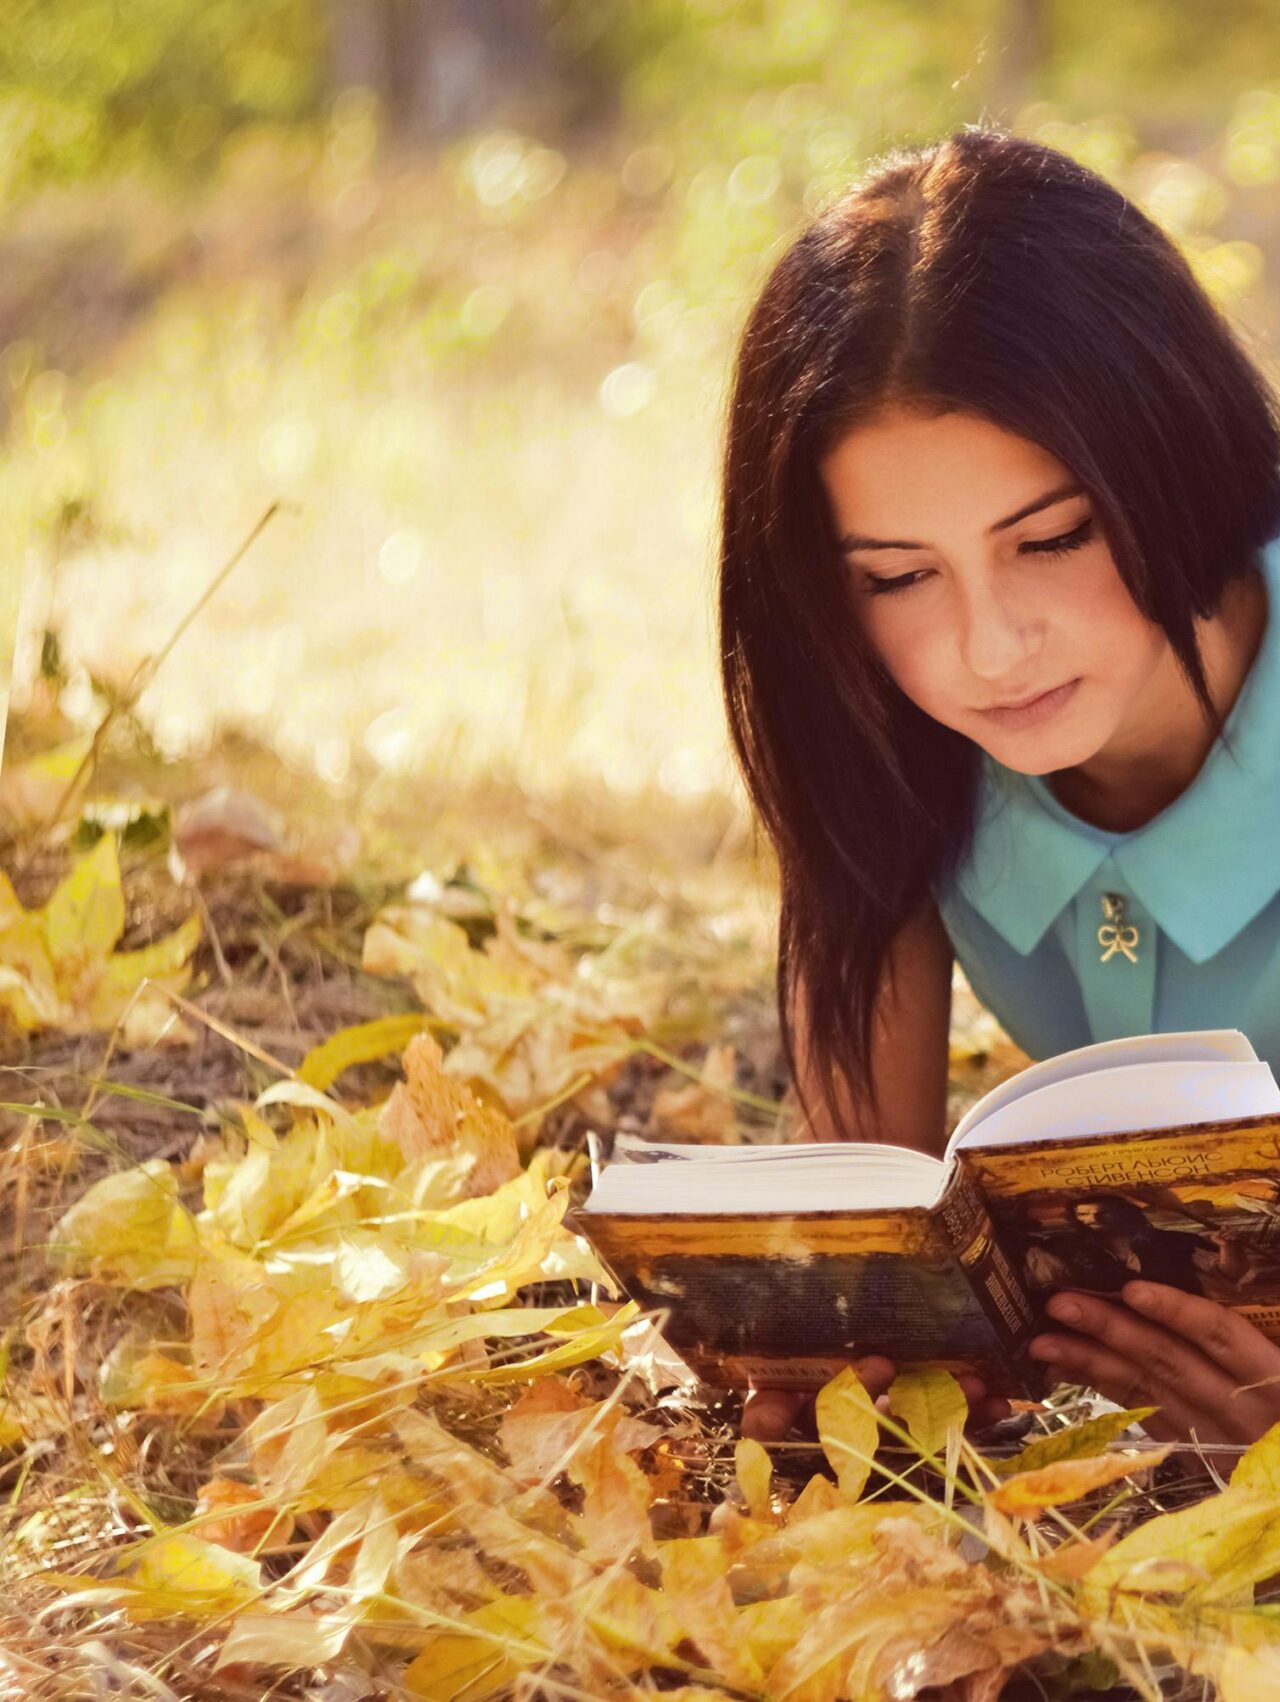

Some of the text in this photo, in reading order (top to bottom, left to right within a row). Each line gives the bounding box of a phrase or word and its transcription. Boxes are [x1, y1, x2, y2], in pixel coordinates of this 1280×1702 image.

[1040, 1151, 1224, 1178] РОБЕРТ ЛЬЮИС
[1065, 1164, 1211, 1187] СТИВЕНСОН
